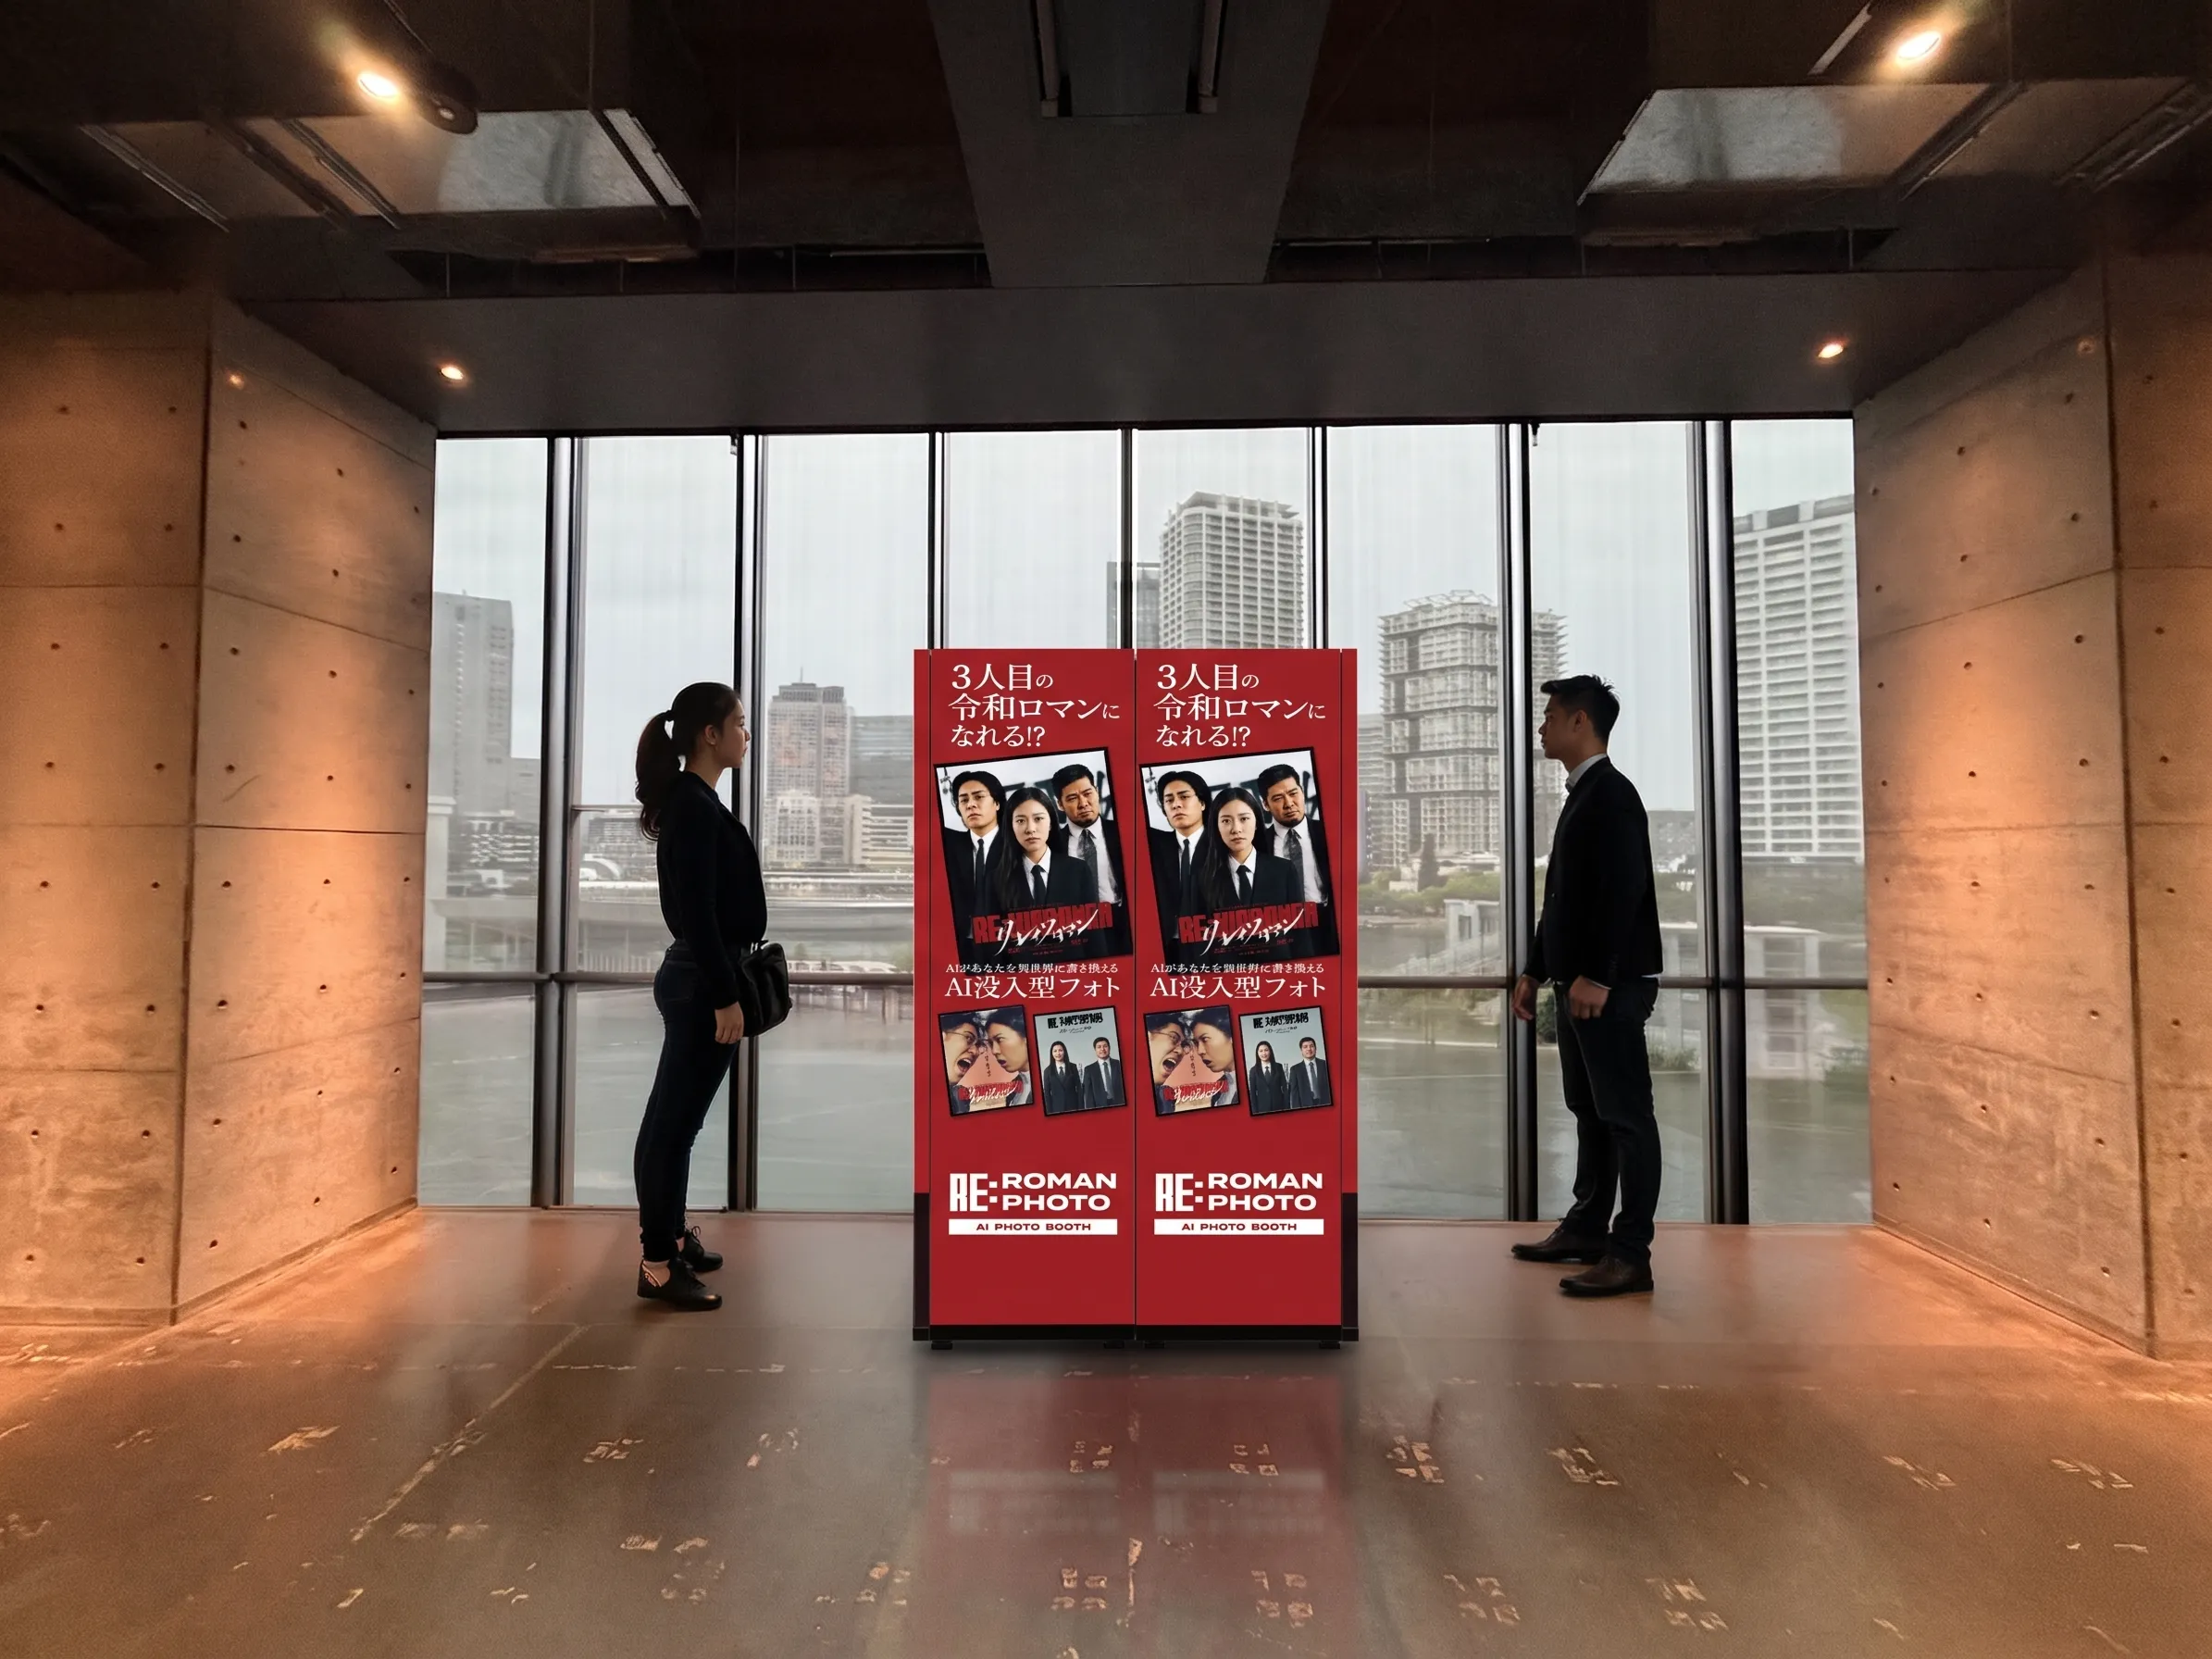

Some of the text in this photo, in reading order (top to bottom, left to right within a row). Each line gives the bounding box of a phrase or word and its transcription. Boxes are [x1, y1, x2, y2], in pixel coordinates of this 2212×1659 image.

[951, 663, 1054, 692] 3人目の
[1157, 663, 1260, 692] 3人目の
[948, 692, 1120, 721] 令和ロマンに
[1153, 692, 1326, 721] 令和ロマンに
[944, 975, 1120, 1000] AI没入型フォト
[1149, 975, 1325, 1000] AI没入型フォト
[1002, 1172, 1117, 1190] ROMAN
[1208, 1172, 1323, 1190] ROMAN
[1002, 1193, 1111, 1212] PHOTO
[1208, 1193, 1317, 1212] PHOTO
[976, 1223, 1091, 1231] AI PHOTO BOOTH
[1181, 1223, 1297, 1231] AI PHOTO BOOTH
